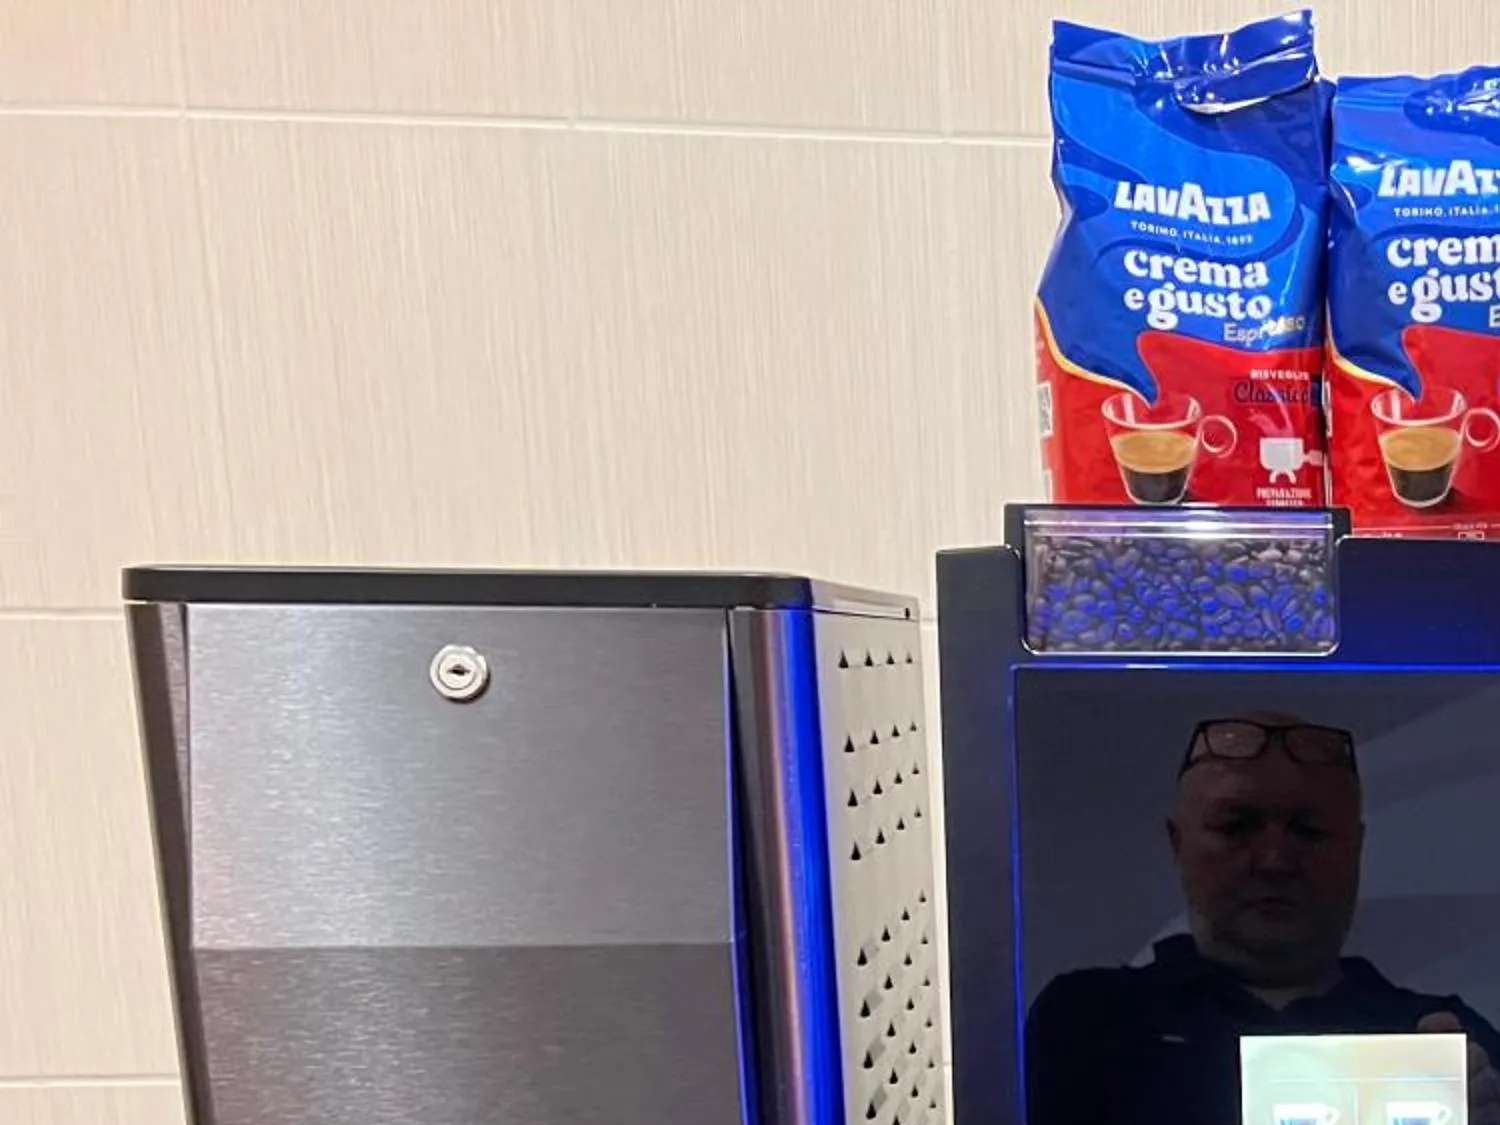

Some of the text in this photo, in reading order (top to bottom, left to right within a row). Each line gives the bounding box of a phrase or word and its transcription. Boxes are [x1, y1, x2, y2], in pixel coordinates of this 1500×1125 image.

[1114, 181, 1271, 225] LAVAZZA
[1123, 250, 1270, 288] crema
[1124, 282, 1272, 330] e gusto
[1388, 281, 1407, 304] e
